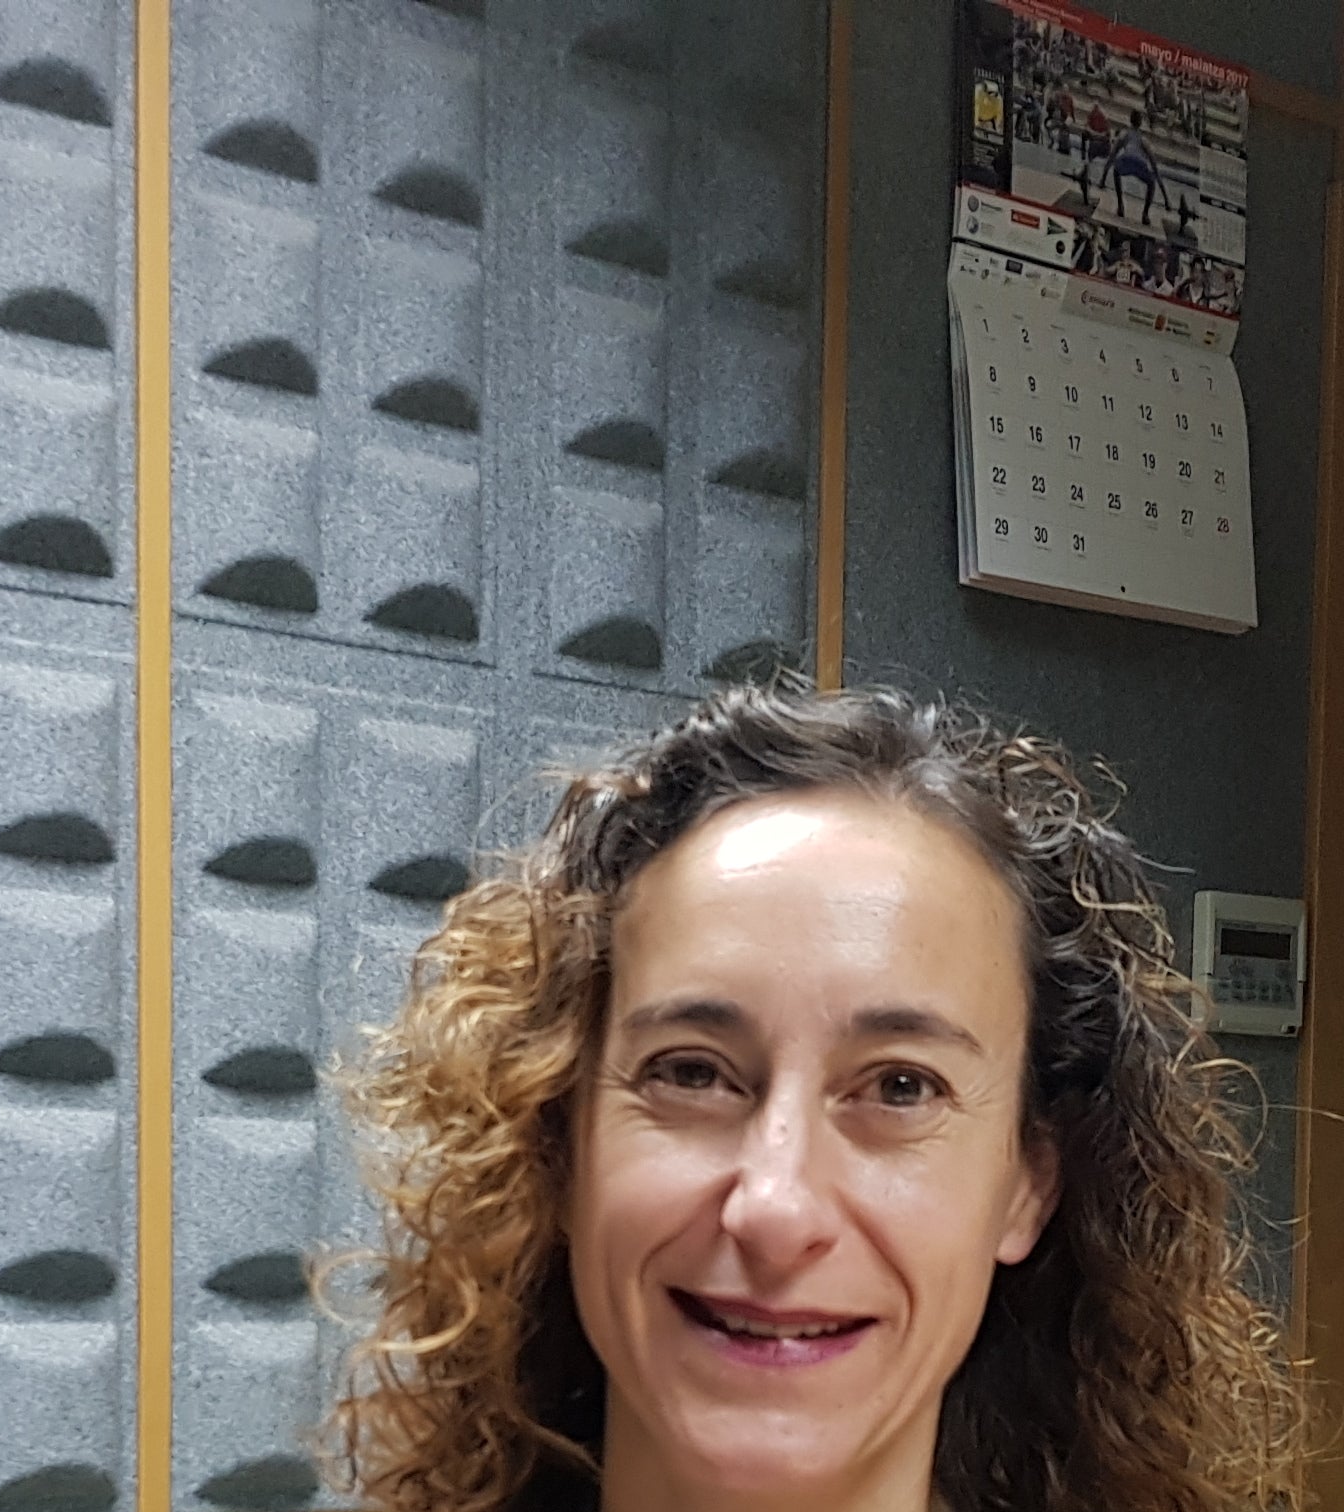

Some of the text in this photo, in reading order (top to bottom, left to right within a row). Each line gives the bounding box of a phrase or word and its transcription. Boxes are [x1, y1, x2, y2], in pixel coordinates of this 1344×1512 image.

[1141, 42, 1172, 65] mayo
[1225, 69, 1249, 87] 2017
[1021, 328, 1031, 344] 2
[1060, 338, 1069, 354] 3
[1099, 349, 1106, 364] 4
[1207, 377, 1213, 391] 7
[989, 365, 1223, 437] 8 9 10 11 12 13 14
[989, 416, 1225, 483] 15 16 17 18 19 20 21
[992, 467, 1230, 532] 22 23 24 25 26 27 28
[994, 518, 1085, 551] 29 30 31
